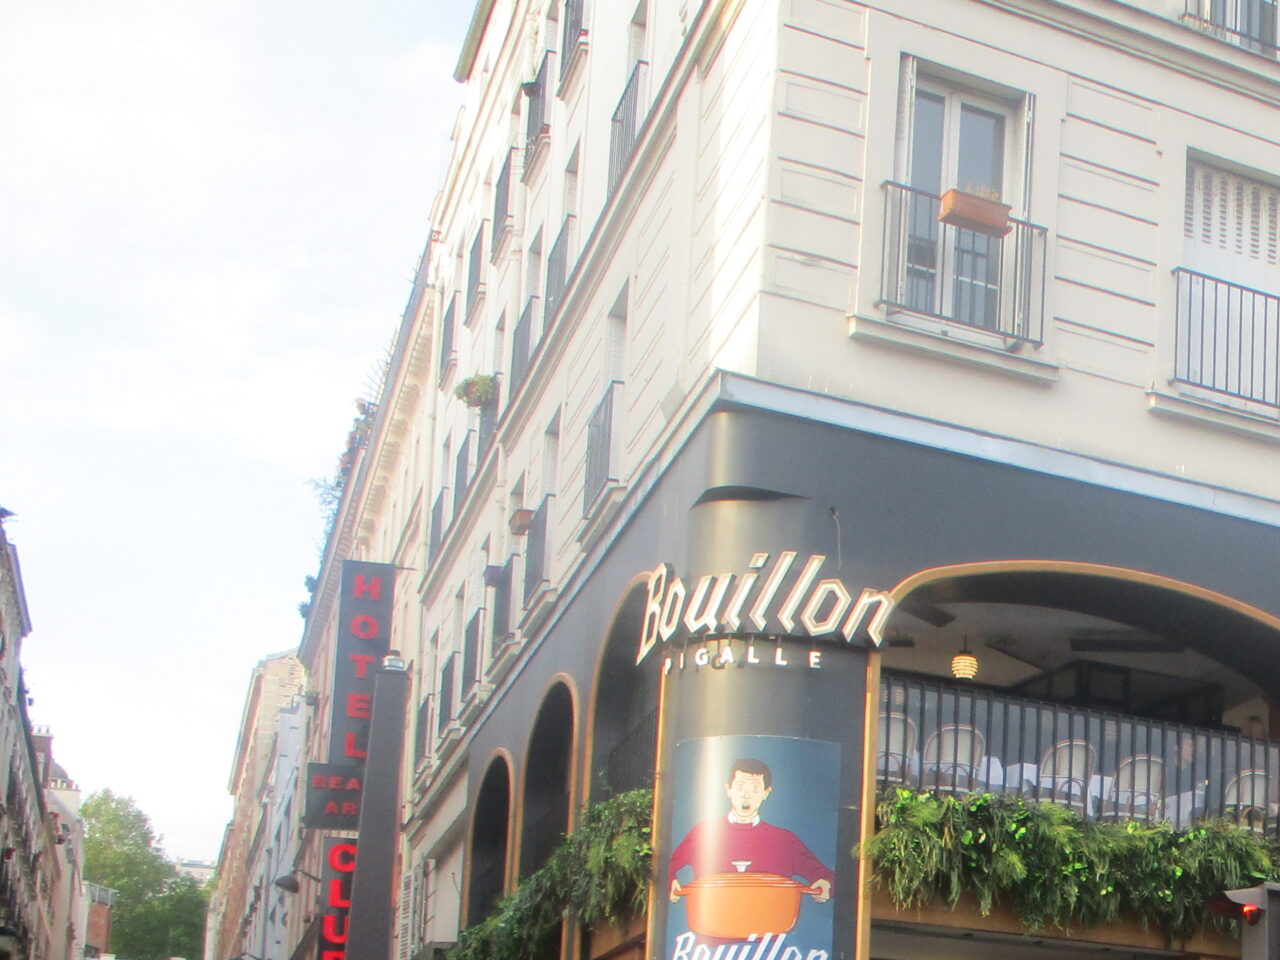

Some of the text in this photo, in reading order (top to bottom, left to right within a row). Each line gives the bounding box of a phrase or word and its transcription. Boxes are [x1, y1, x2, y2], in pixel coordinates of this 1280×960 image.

[636, 550, 896, 666] Bouillon
[343, 574, 382, 758] HOTEL
[664, 647, 822, 675] PIGALLE
[311, 776, 362, 790] BEA
[324, 802, 357, 815] AR
